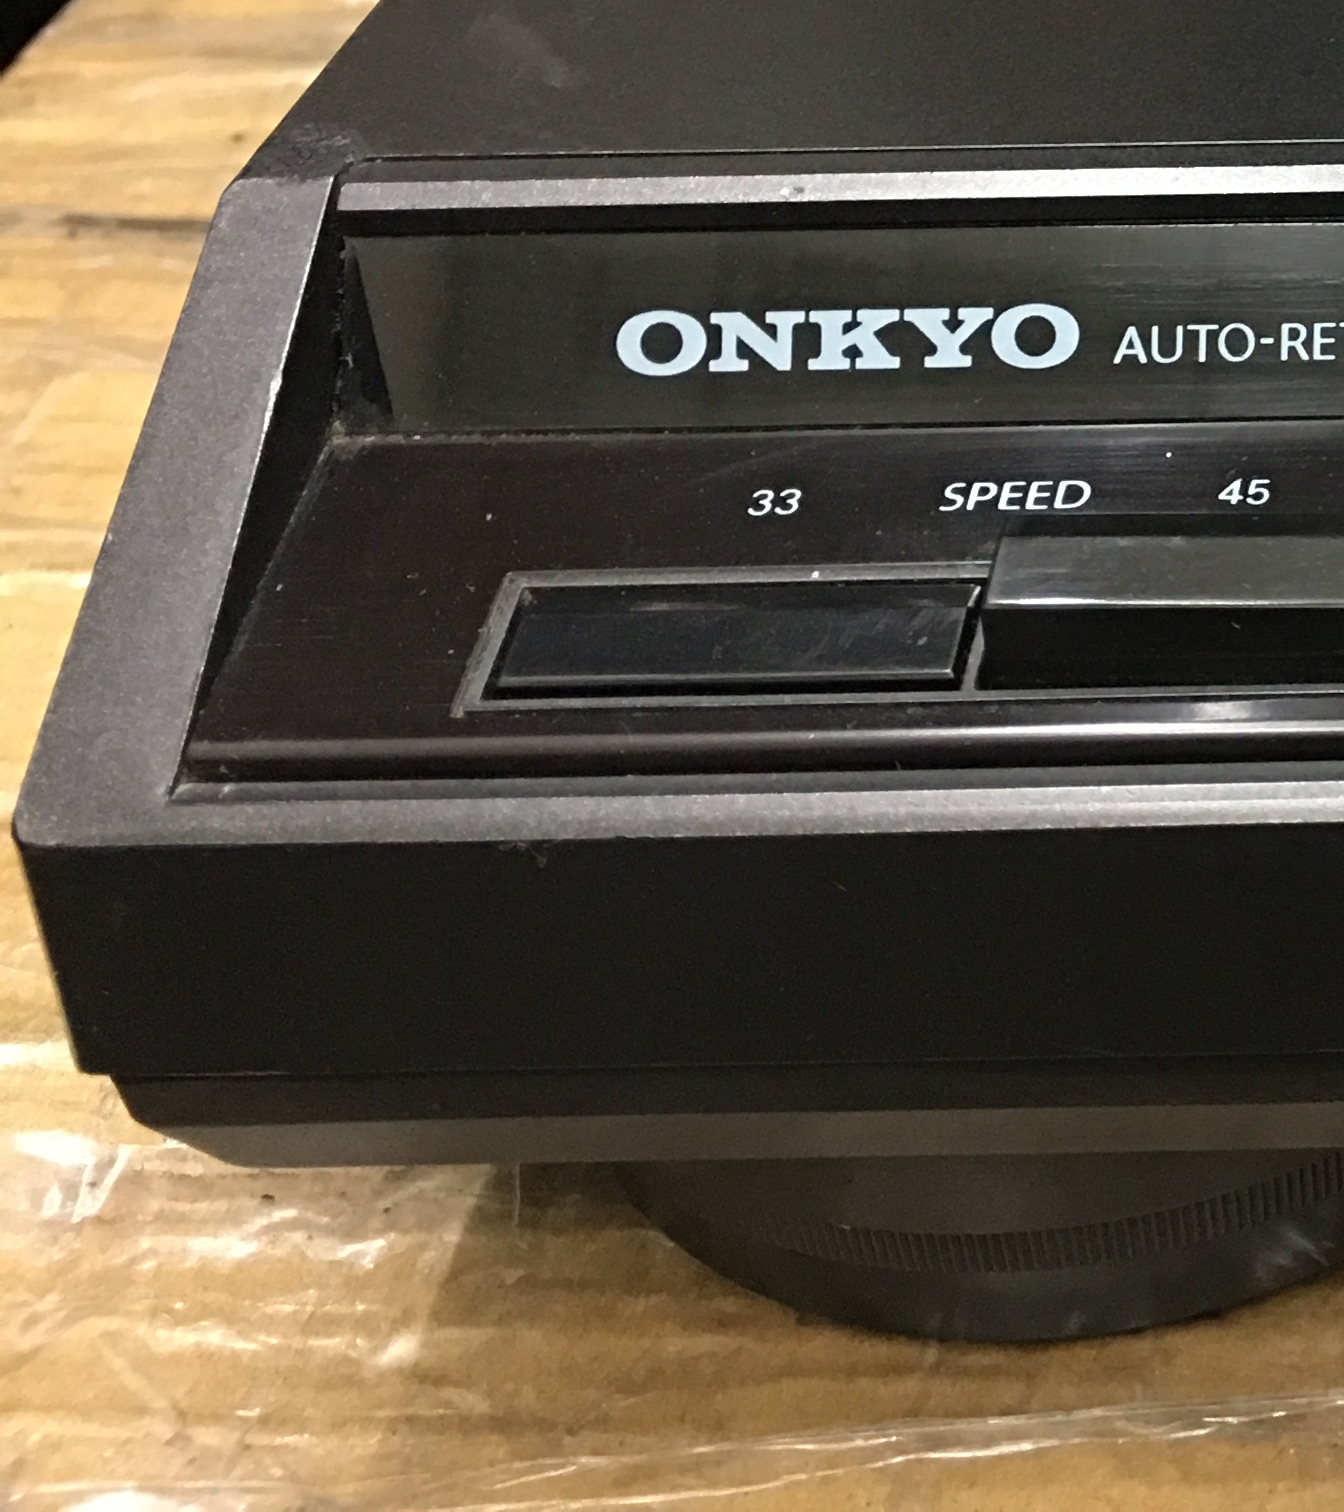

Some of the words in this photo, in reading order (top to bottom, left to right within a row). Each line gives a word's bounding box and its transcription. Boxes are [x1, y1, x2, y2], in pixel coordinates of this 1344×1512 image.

[616, 303, 1080, 377] ONKYO
[747, 488, 802, 516] 33
[938, 480, 1092, 512] SPEED
[1217, 478, 1271, 505] 45
